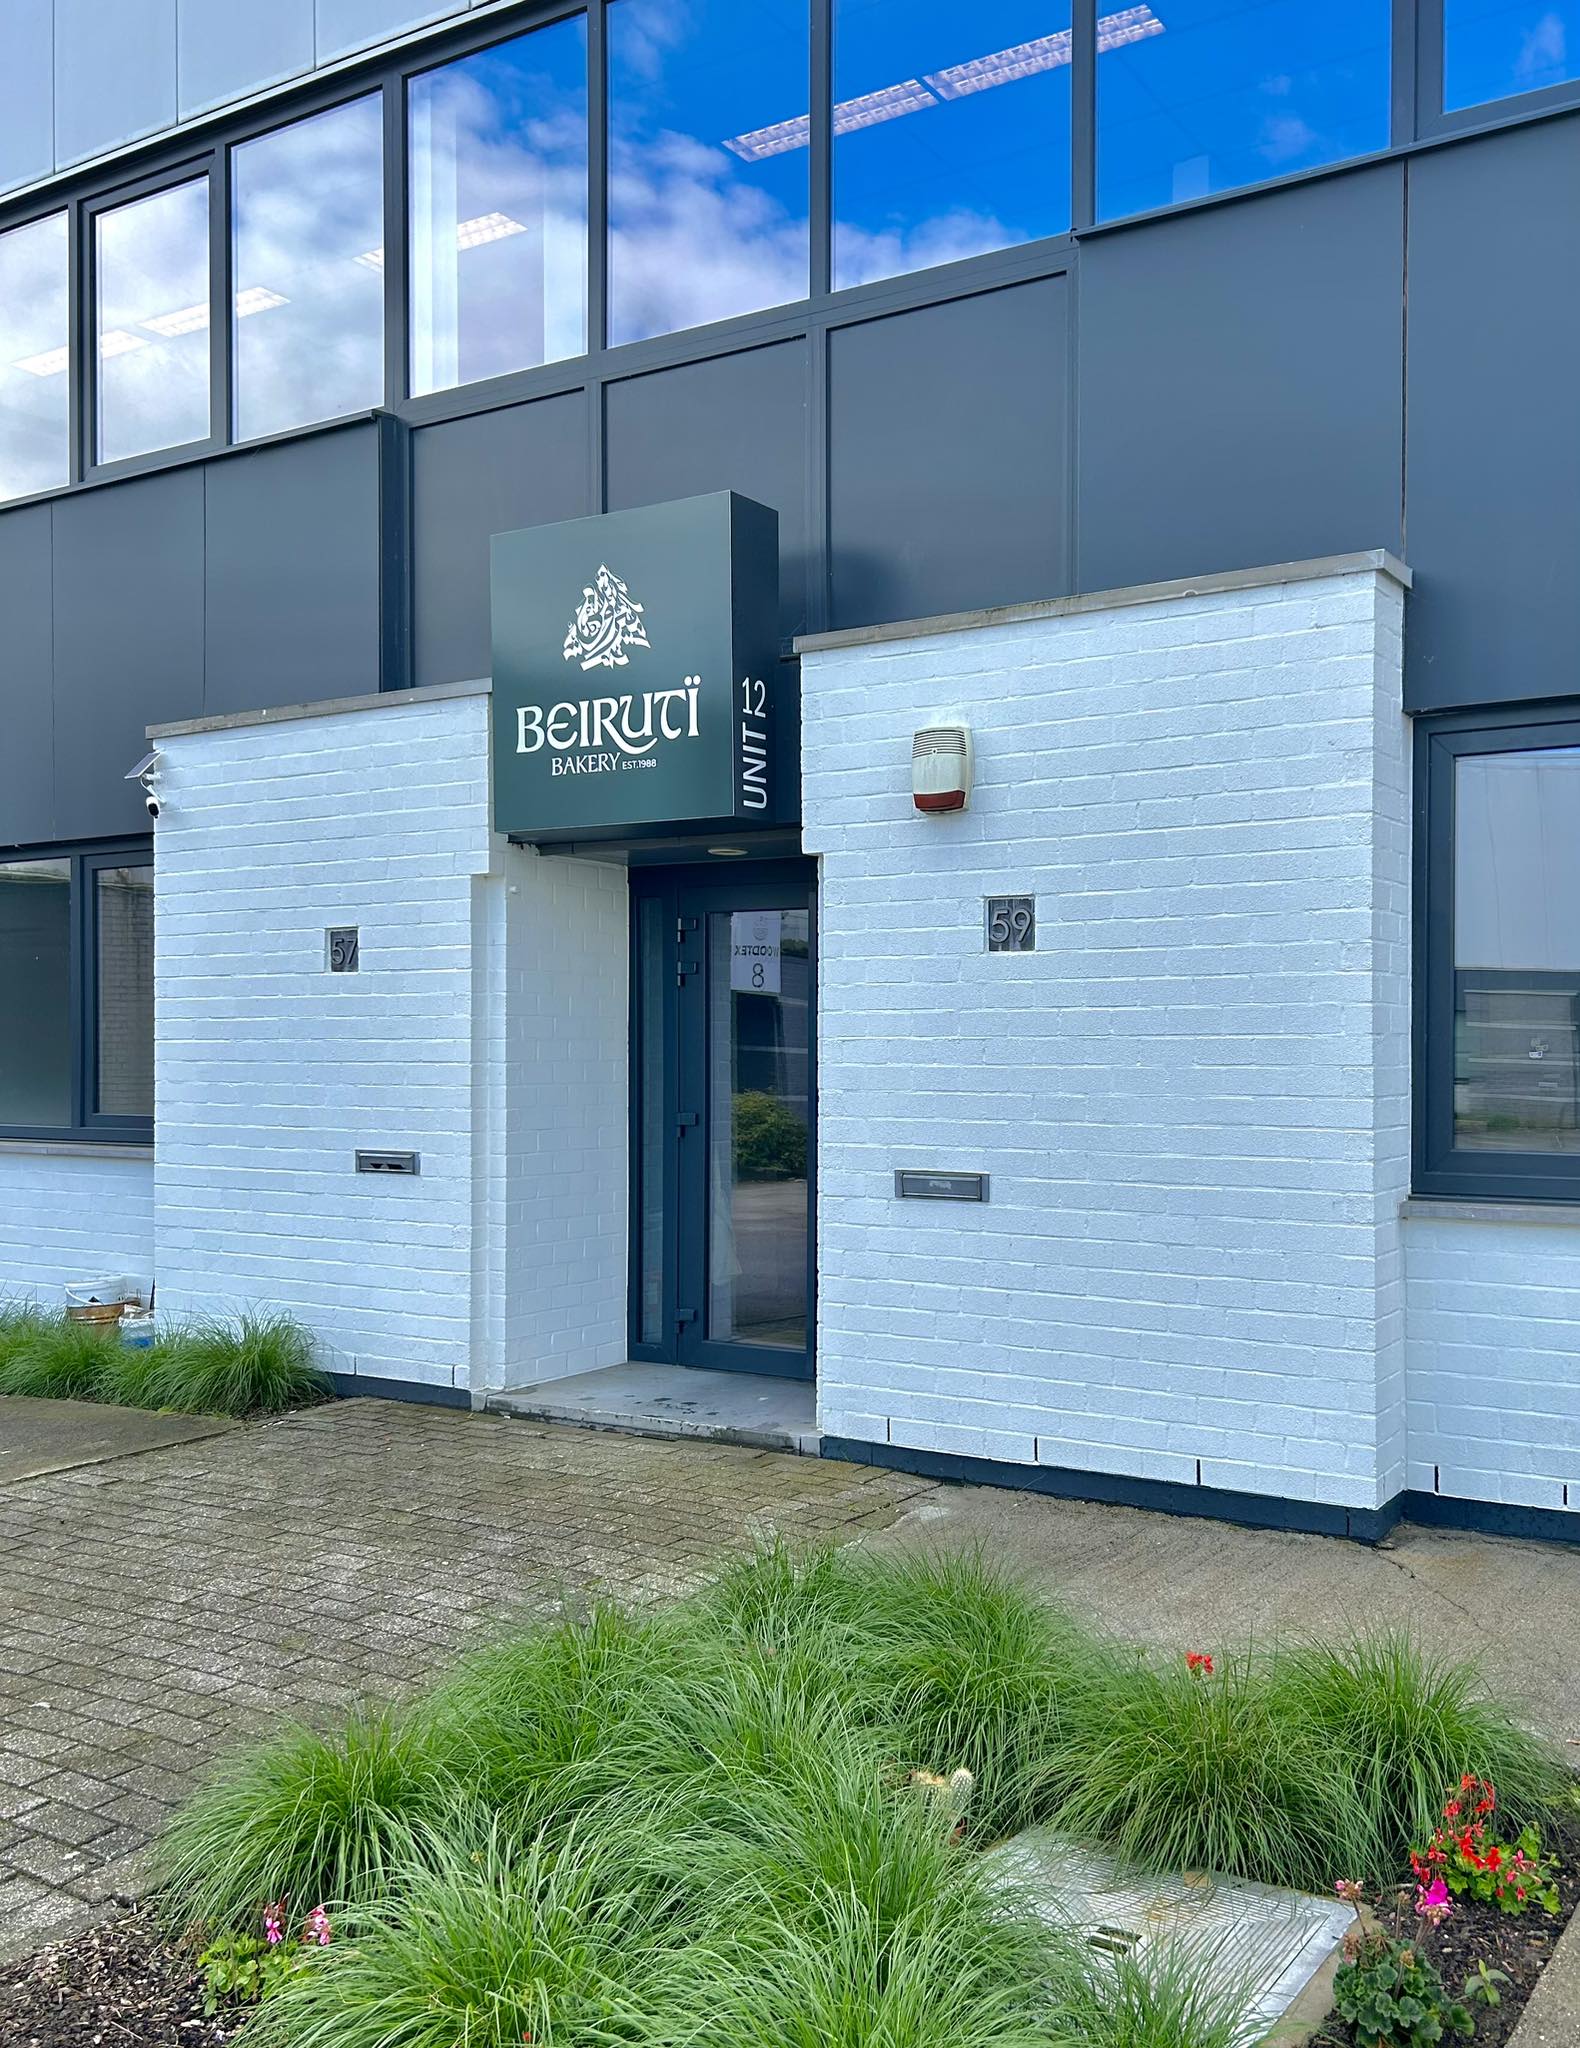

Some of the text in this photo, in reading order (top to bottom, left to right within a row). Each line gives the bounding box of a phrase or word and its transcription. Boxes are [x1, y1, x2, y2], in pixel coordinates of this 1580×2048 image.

[742, 676, 767, 809] UNIT 12
[551, 752, 621, 776] BAKERY
[990, 907, 1032, 943] 59
[332, 938, 358, 965] 57
